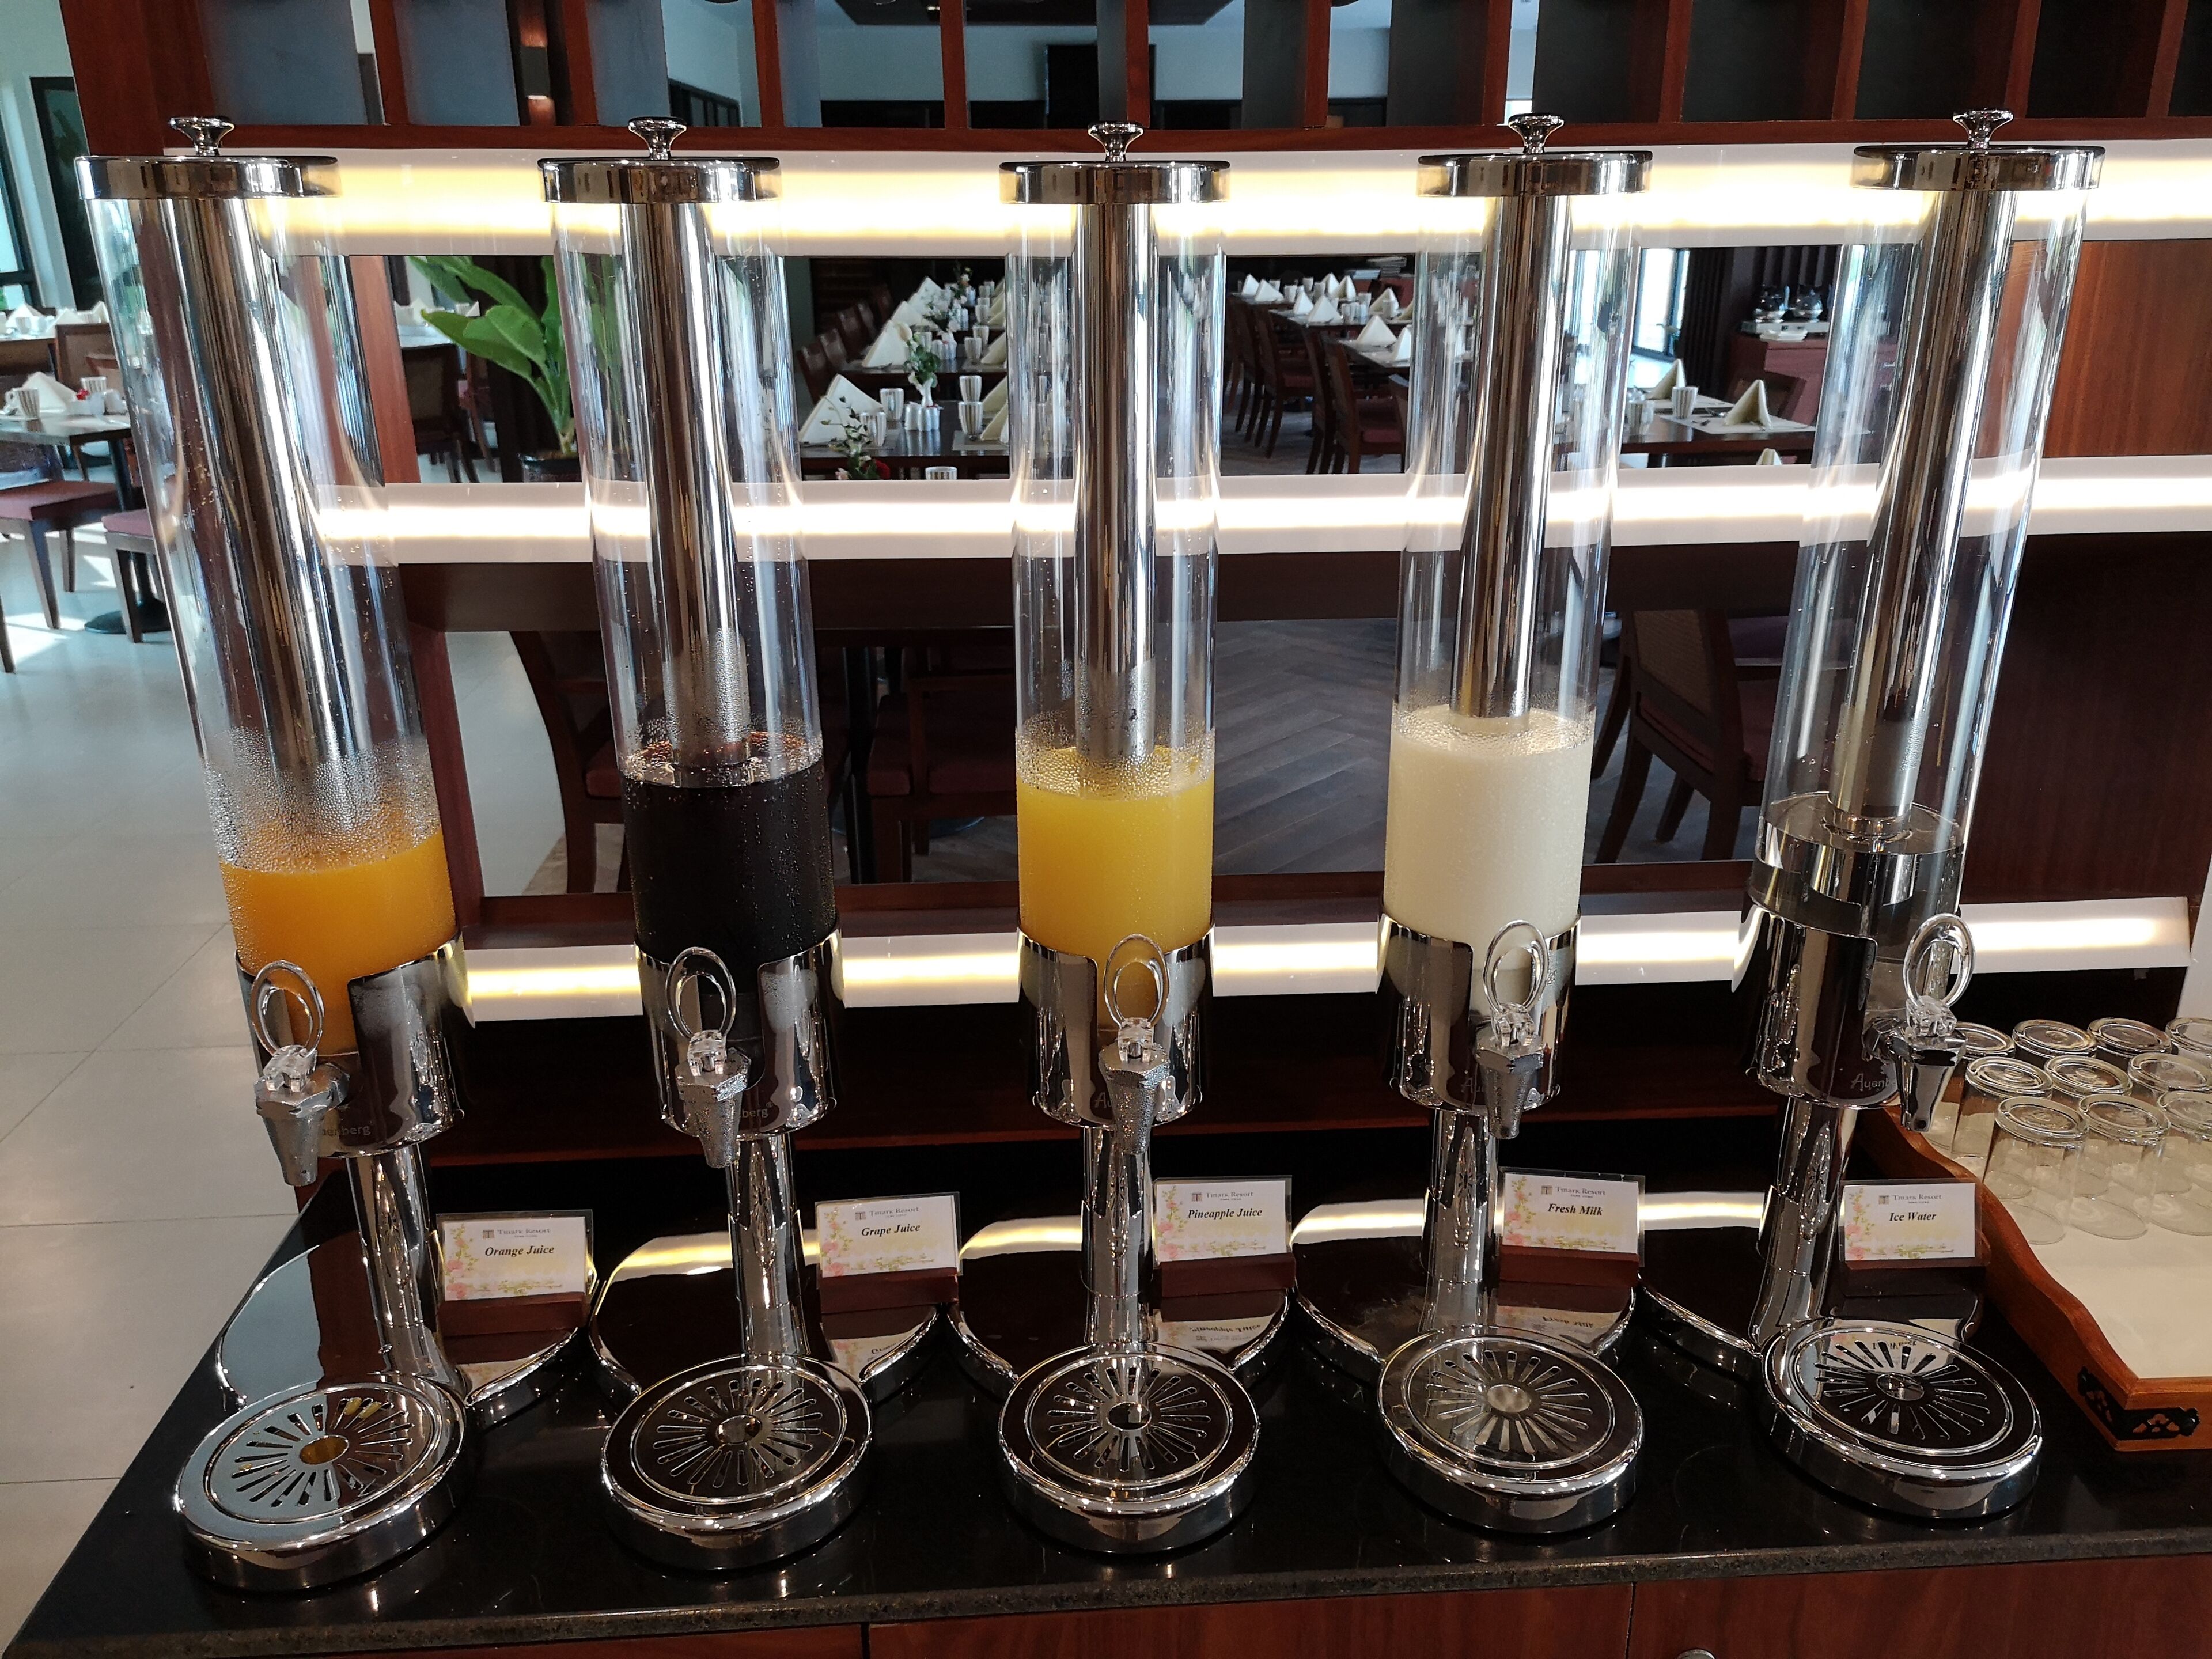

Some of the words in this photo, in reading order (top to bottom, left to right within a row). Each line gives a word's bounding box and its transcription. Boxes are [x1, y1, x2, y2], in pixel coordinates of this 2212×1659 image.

[742, 1108, 769, 1118] berg
[1188, 1209, 1235, 1220] Pineapple
[1237, 1208, 1263, 1217] Juice
[1548, 1203, 1576, 1214] Fresh
[1579, 1206, 1603, 1216] Milk
[1889, 1212, 1904, 1221] Ice
[1908, 1212, 1937, 1221] Water
[861, 1227, 891, 1238] Grape
[894, 1224, 921, 1234] Juice
[485, 1246, 524, 1257] Orange
[526, 1245, 555, 1255] Juice
